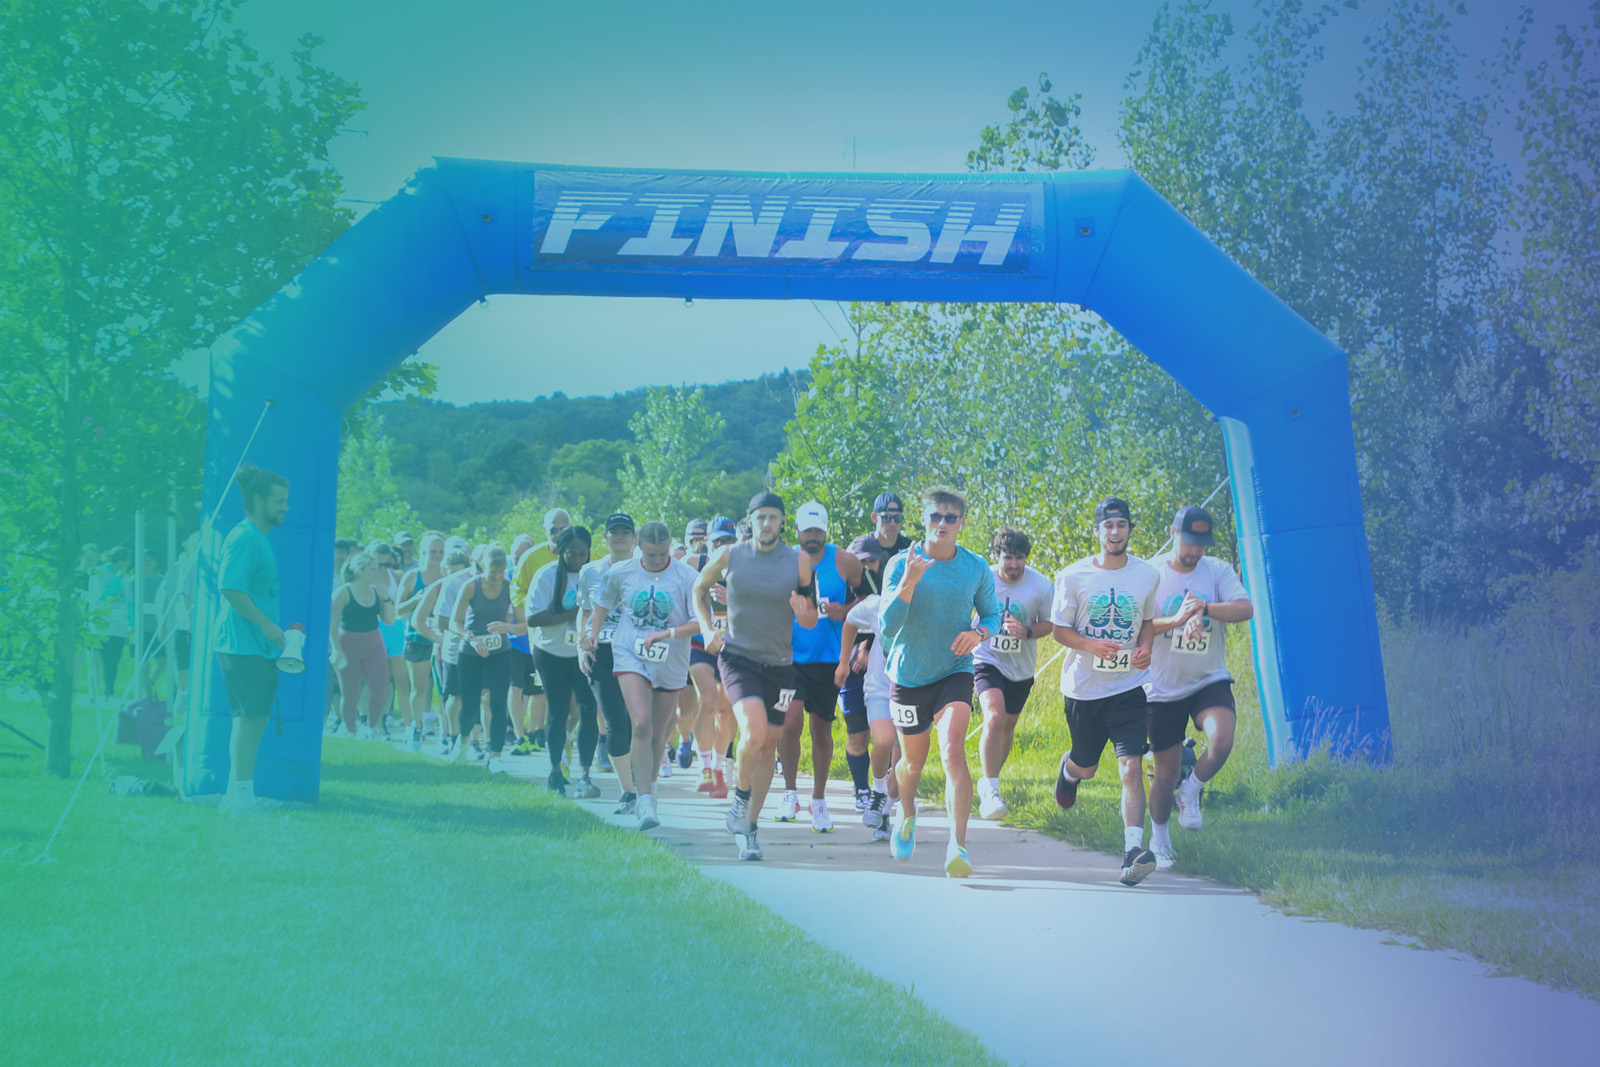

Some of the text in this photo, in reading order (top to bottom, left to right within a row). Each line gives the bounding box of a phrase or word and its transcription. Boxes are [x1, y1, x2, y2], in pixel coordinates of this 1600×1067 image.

[540, 191, 1026, 265] FINISH
[992, 637, 1019, 651] 103
[1175, 634, 1207, 651] 165
[637, 643, 667, 660] 167
[1096, 653, 1129, 669] 134
[897, 708, 915, 724] 19
